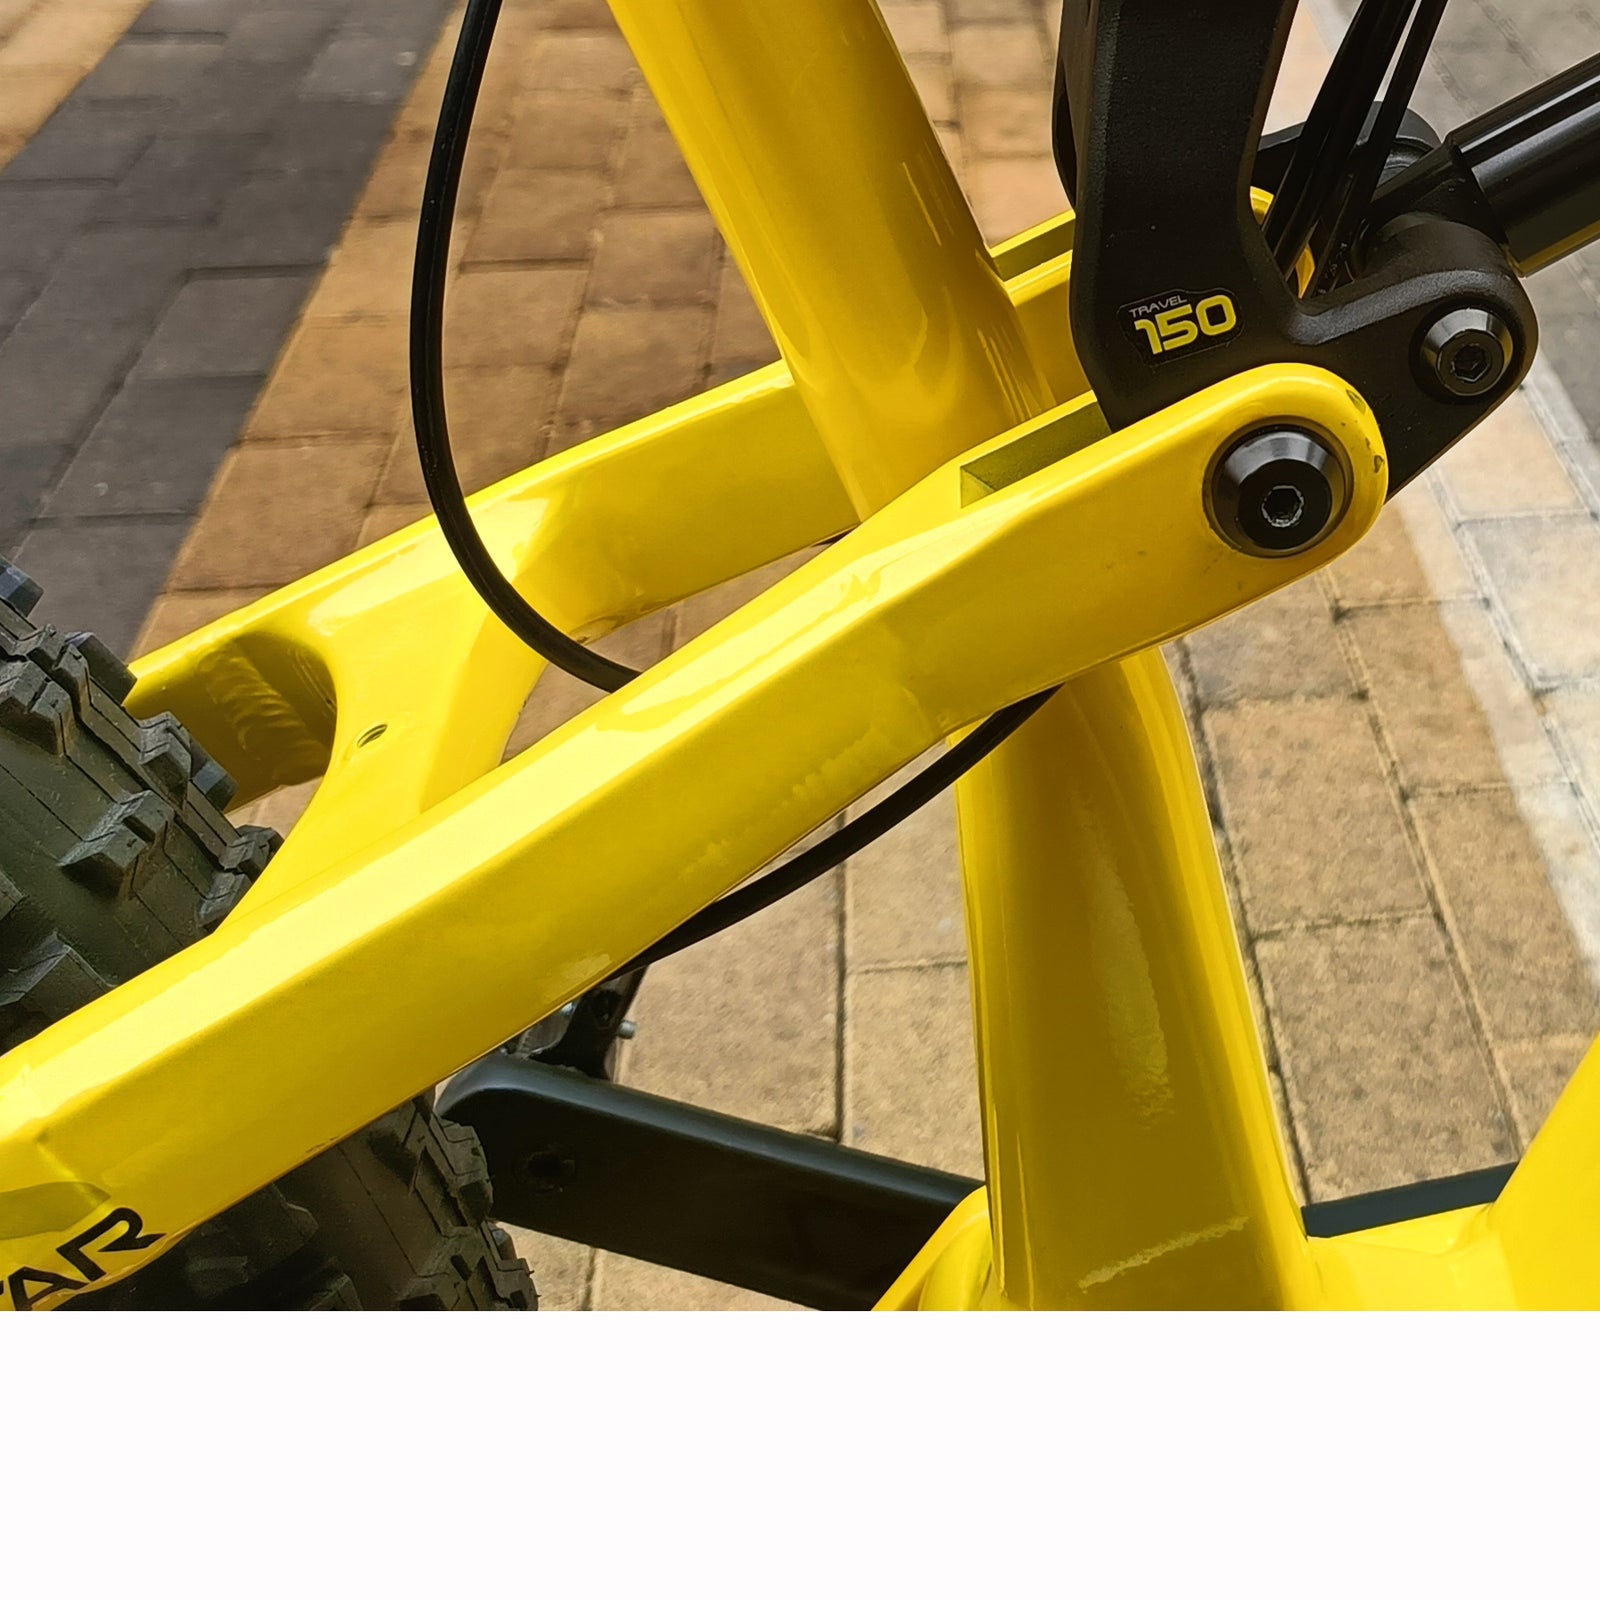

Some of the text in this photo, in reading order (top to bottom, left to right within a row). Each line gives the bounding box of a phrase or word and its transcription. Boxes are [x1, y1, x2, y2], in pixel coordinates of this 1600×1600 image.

[1128, 294, 1188, 318] TRAVEL
[1133, 294, 1237, 355] 150
[0, 1206, 167, 1311] AR
